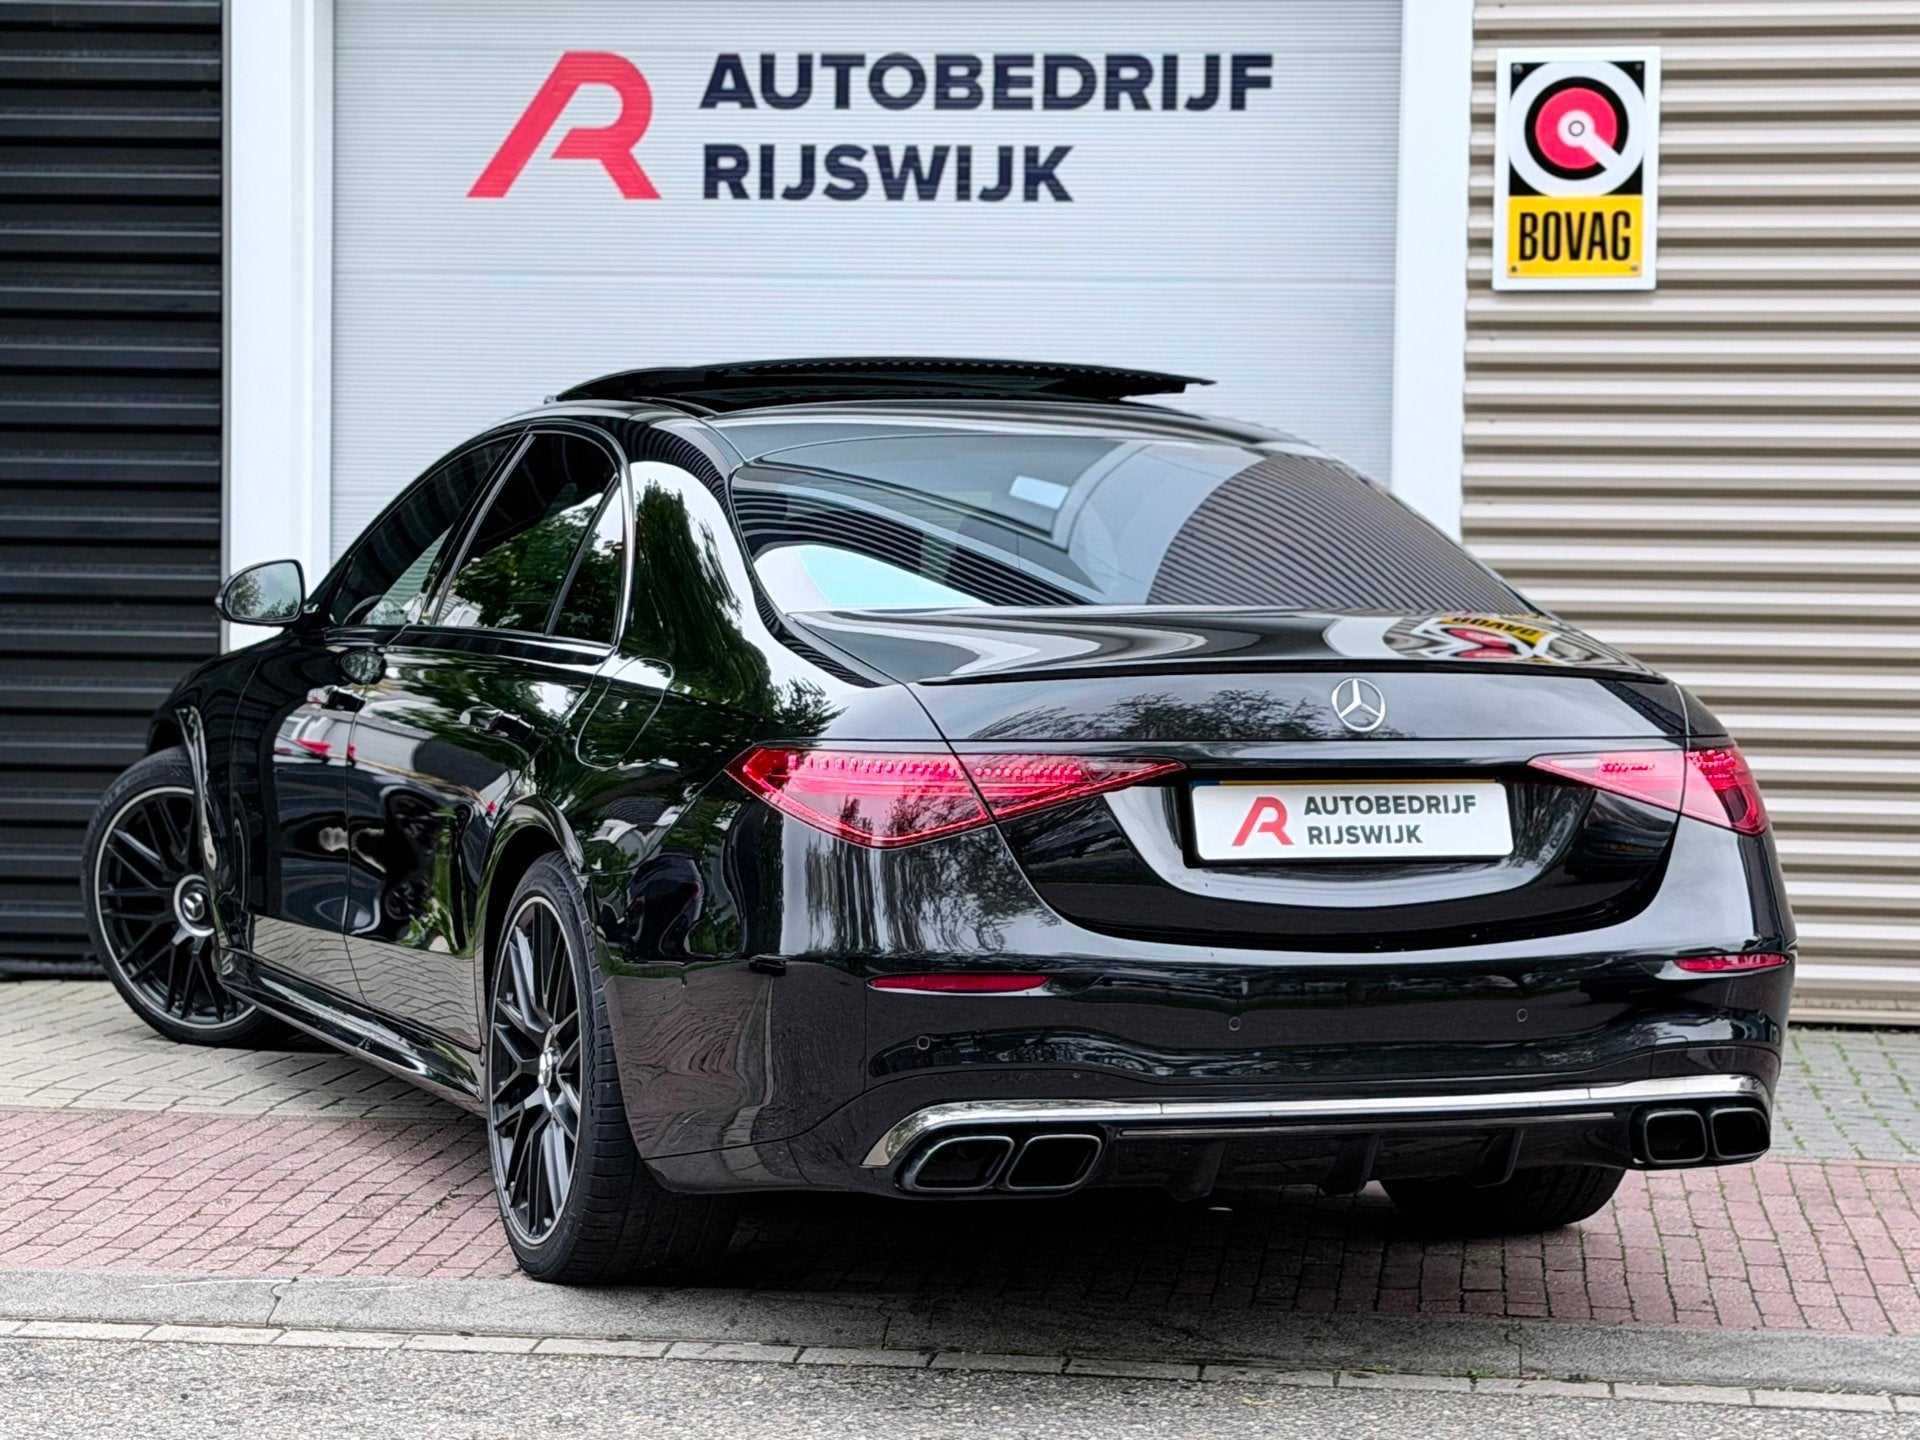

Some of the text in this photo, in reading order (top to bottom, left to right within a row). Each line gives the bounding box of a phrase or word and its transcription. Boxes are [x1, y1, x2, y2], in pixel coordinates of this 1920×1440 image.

[699, 53, 1273, 112] AUTOBEDRIJF
[702, 144, 1073, 202] RIJSWIJK
[1518, 210, 1631, 262] BOVAG
[1304, 795, 1476, 815] AUTOBEDRIJF
[1307, 825, 1422, 845] RIJSWIJK
